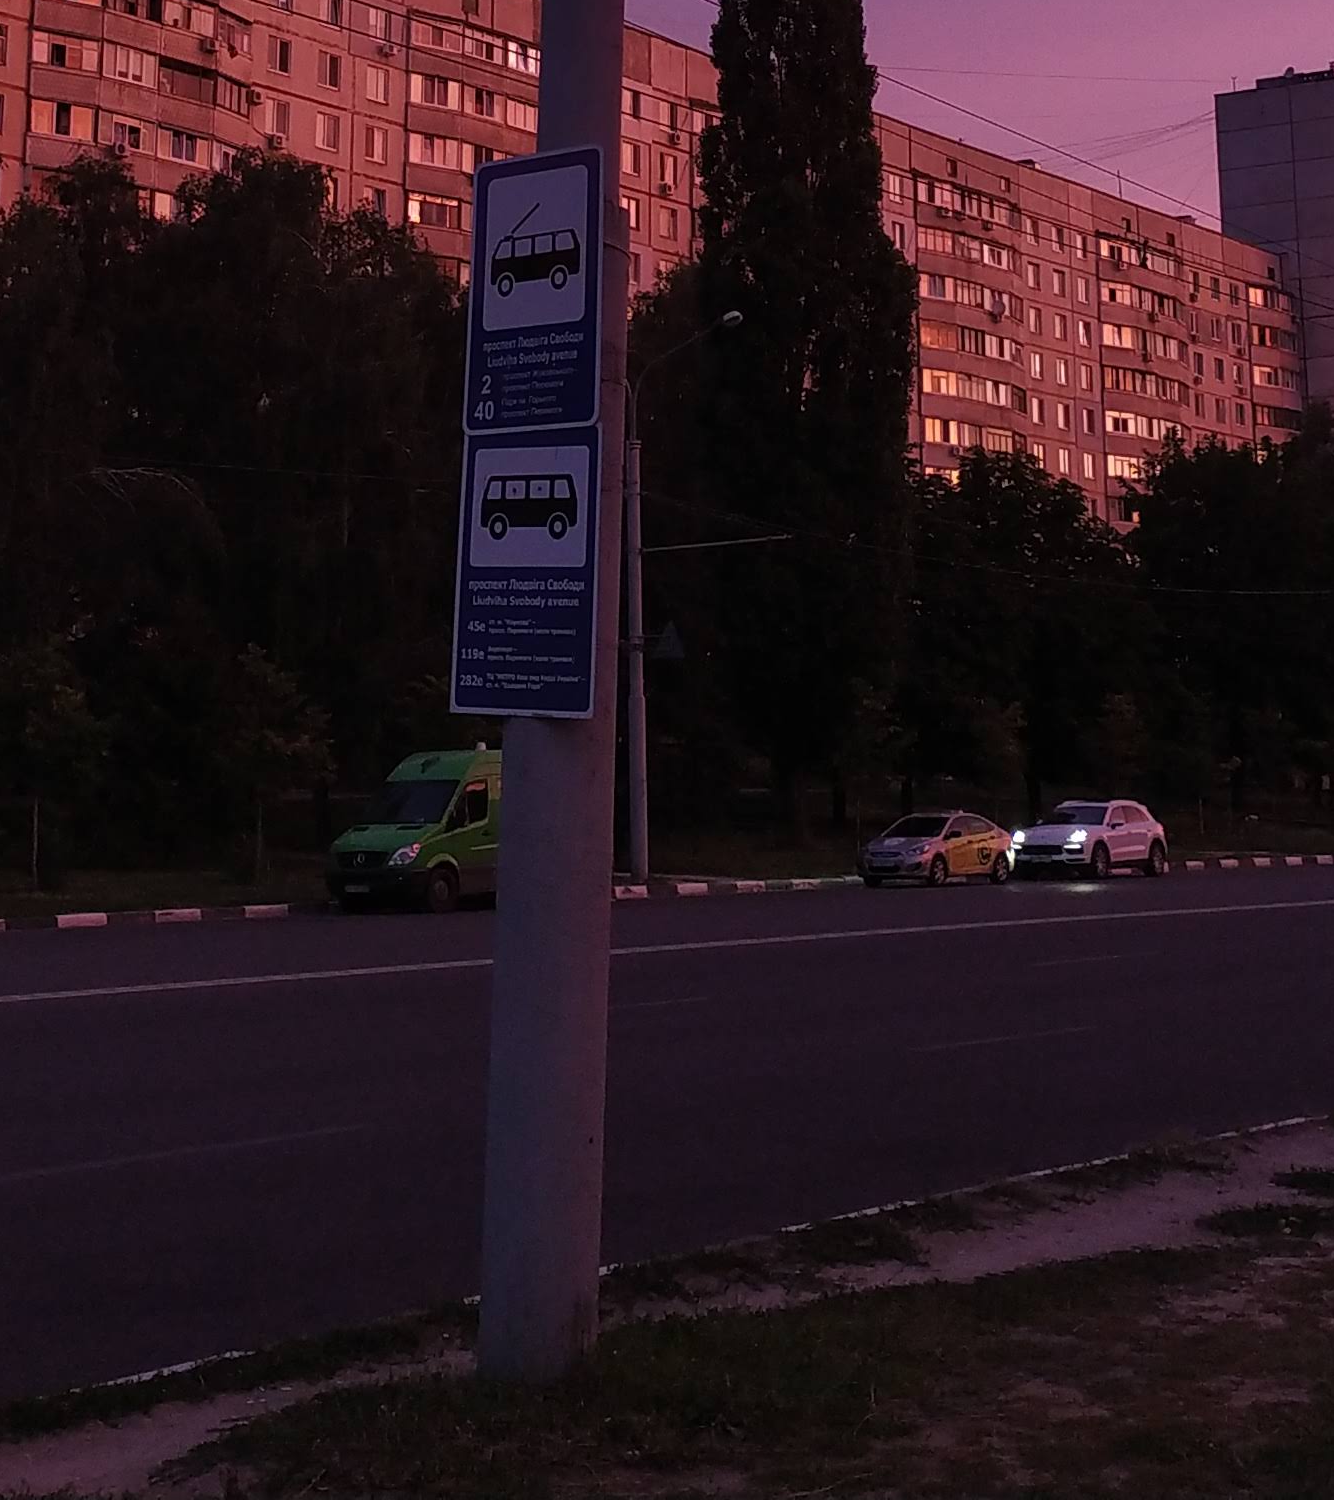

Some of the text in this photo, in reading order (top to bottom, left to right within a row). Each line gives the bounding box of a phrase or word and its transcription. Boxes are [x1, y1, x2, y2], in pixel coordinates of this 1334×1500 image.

[483, 339, 517, 353] проспект
[550, 331, 584, 345] Свободи
[518, 350, 550, 364] Svobody
[552, 349, 578, 361] avenue
[481, 375, 492, 395] 2
[474, 400, 495, 420] 40
[468, 578, 585, 592] проспект Людвіга Свободи
[509, 595, 546, 609] Svobody
[547, 597, 579, 607] avenue
